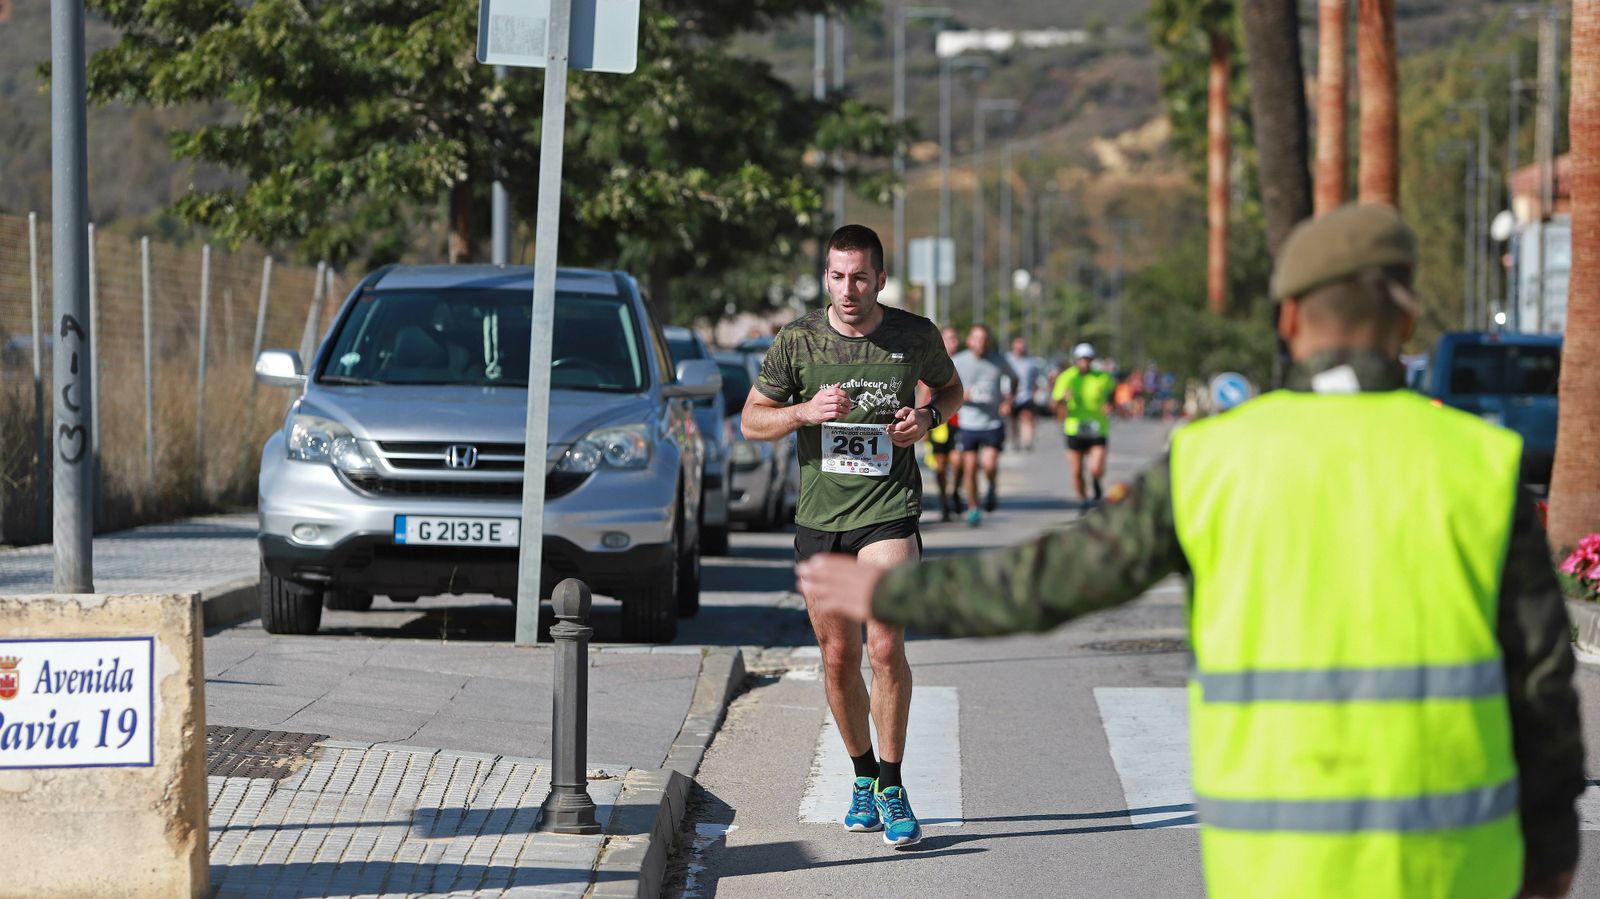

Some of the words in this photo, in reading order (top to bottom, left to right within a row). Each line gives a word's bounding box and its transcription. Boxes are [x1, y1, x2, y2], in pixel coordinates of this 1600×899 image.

[833, 436, 878, 455] 261
[32, 657, 134, 695] Avenida
[0, 709, 80, 751] avia
[94, 708, 137, 749] 19
